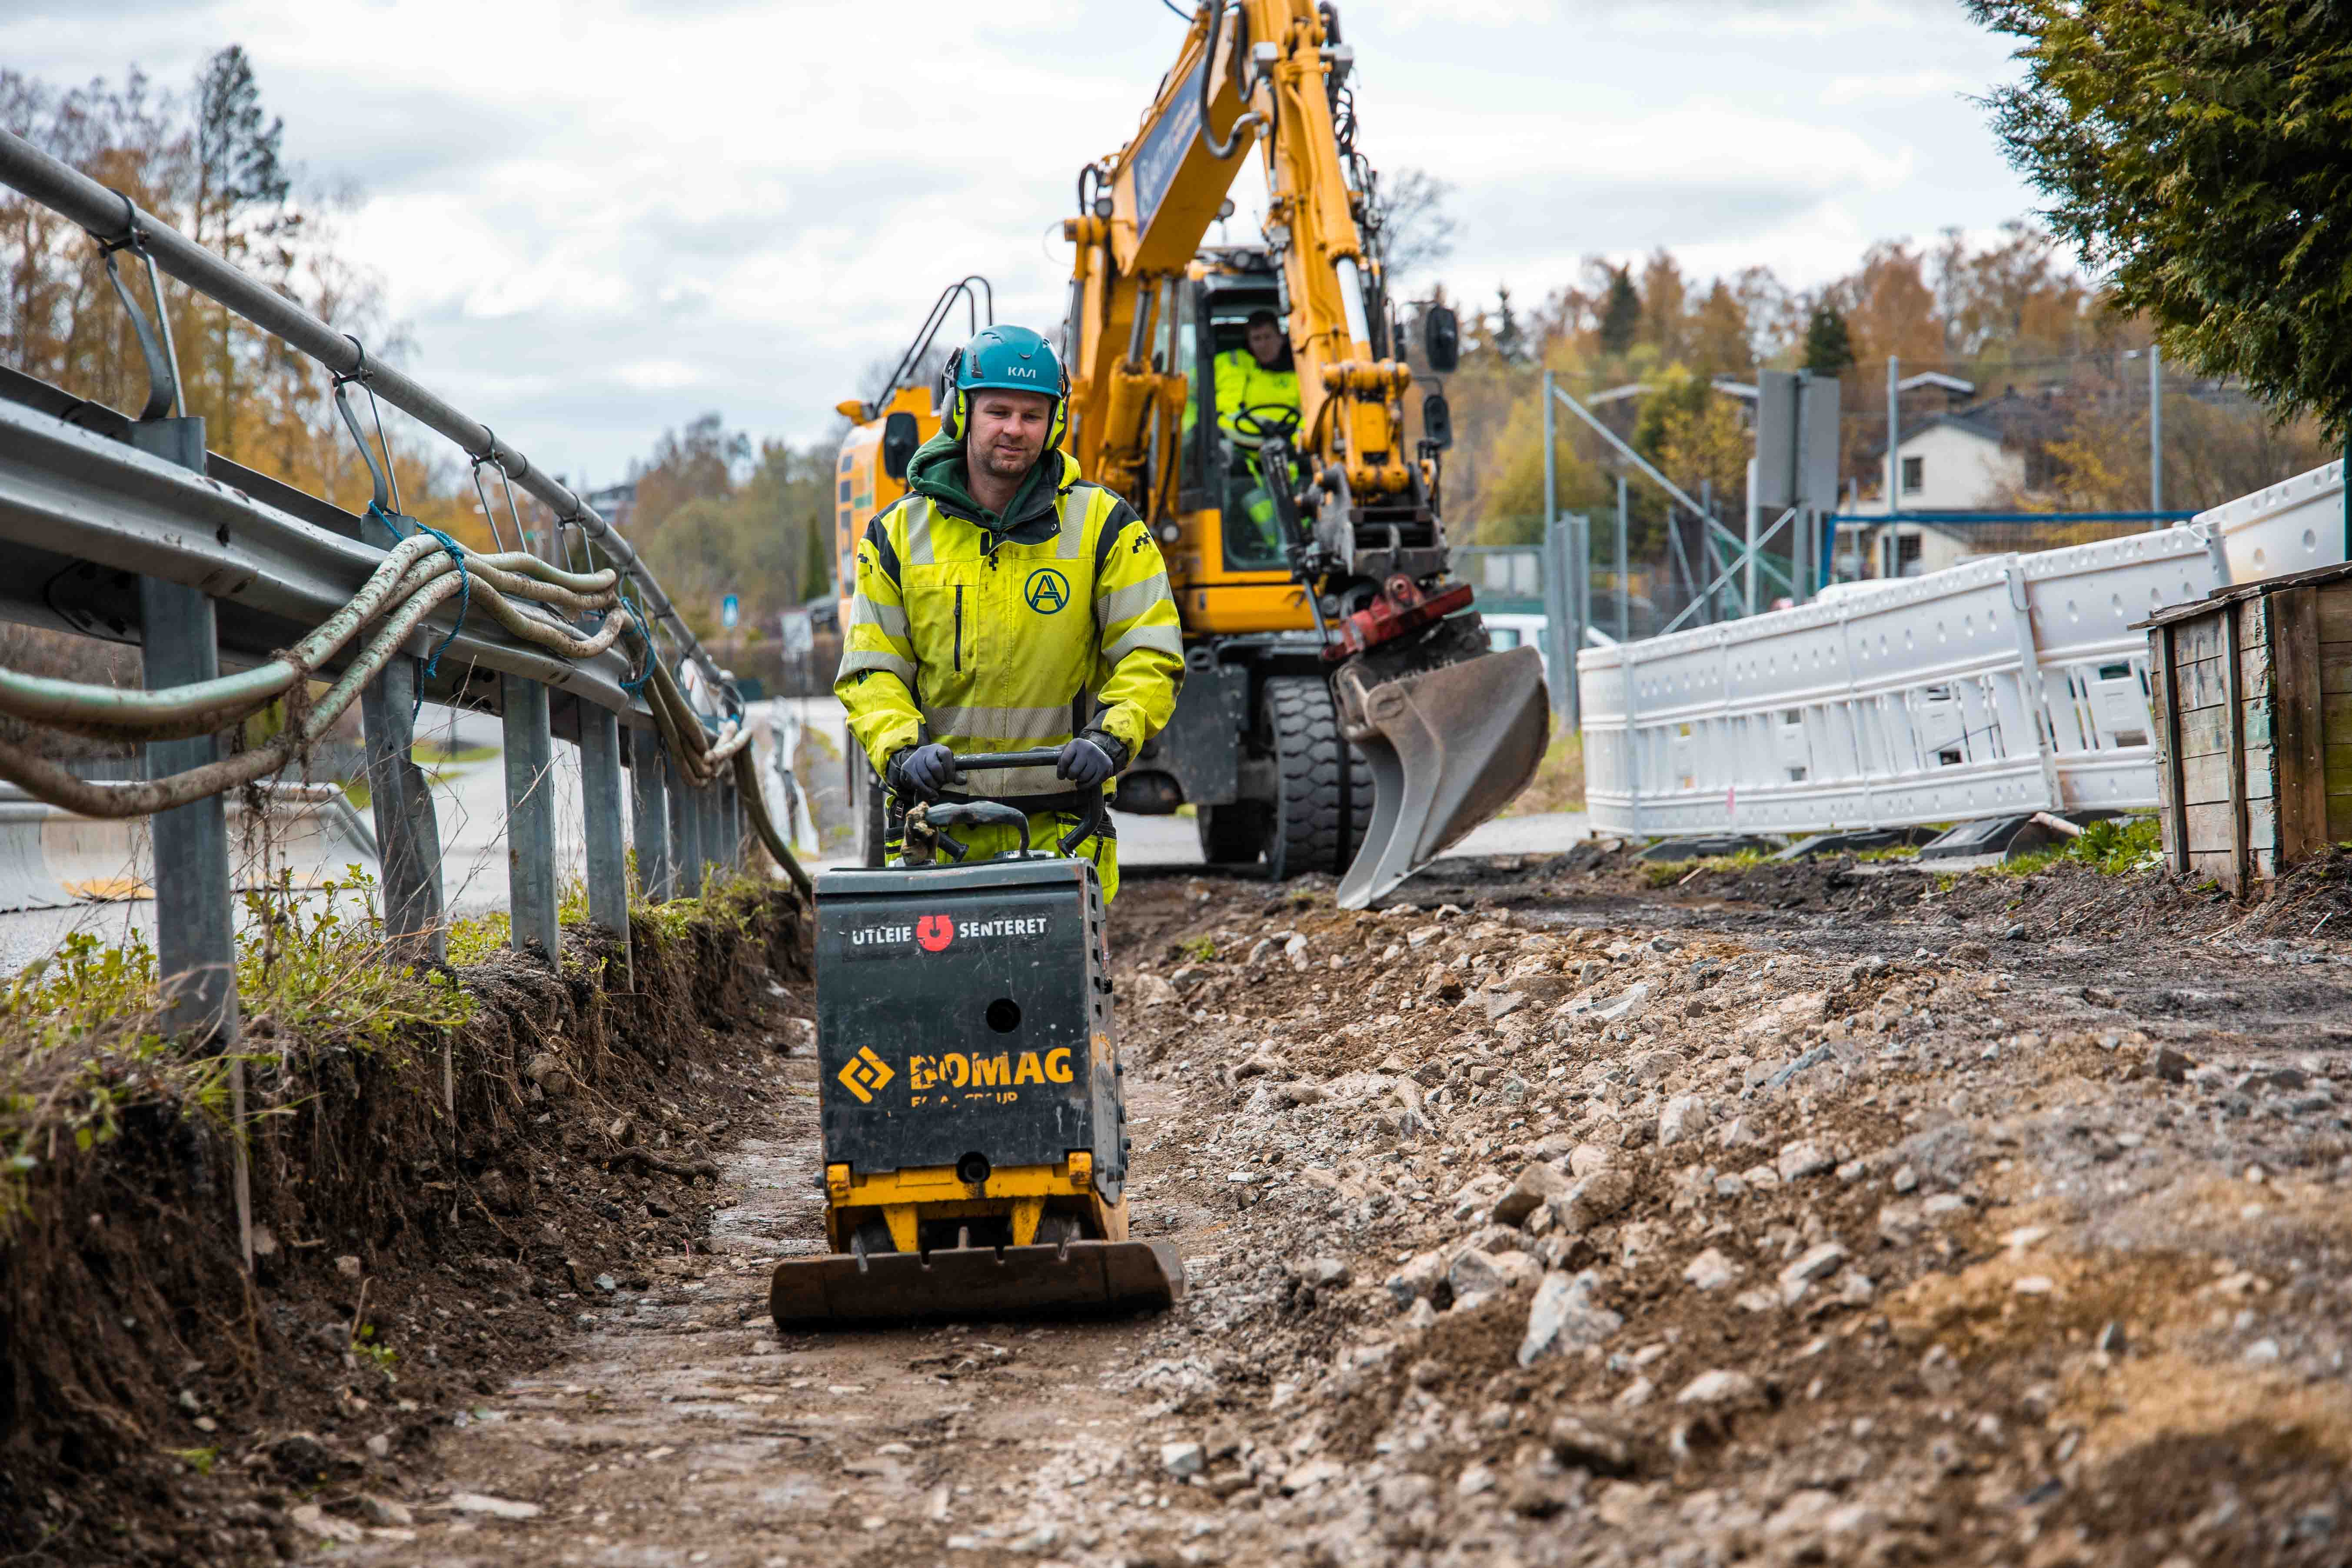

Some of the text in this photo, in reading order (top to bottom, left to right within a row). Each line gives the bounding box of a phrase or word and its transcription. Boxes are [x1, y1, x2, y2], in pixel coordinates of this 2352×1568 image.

[852, 925, 912, 945] UTLEIE
[959, 918, 1047, 939] SENTERET
[910, 1047, 1074, 1090] BOMAG
